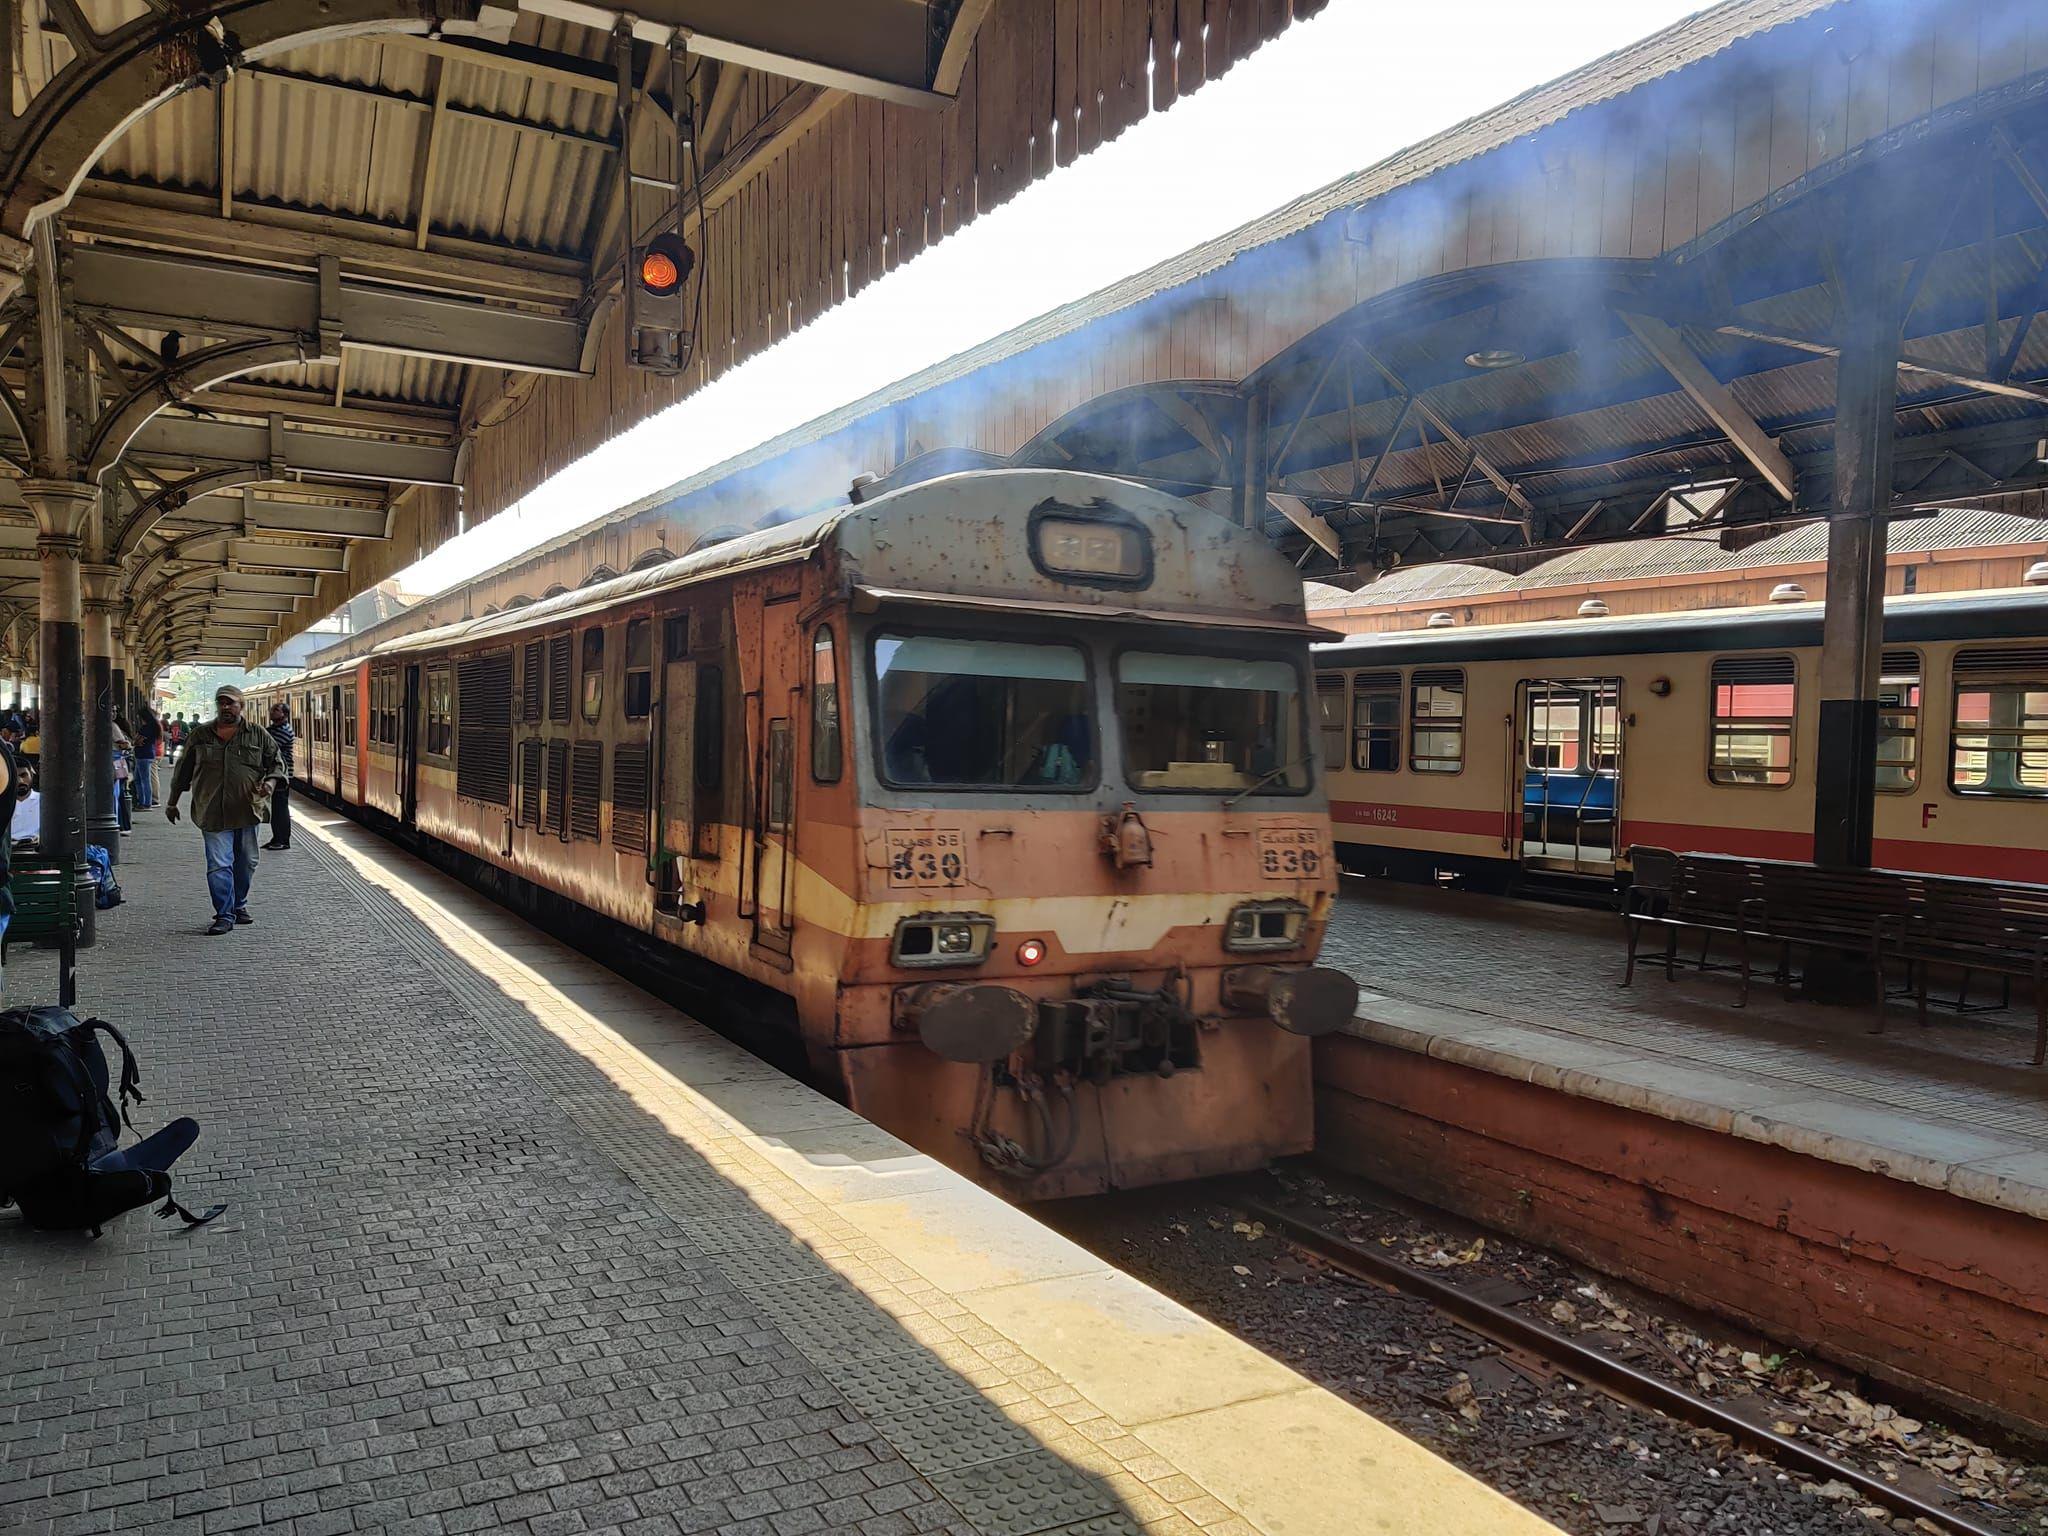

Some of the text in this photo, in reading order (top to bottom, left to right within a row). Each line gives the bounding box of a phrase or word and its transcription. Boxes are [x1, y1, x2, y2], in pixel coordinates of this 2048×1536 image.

[1372, 808, 1397, 821] 16242
[1921, 802, 1938, 829] F
[893, 852, 961, 880] 830
[1263, 849, 1320, 873] 830
